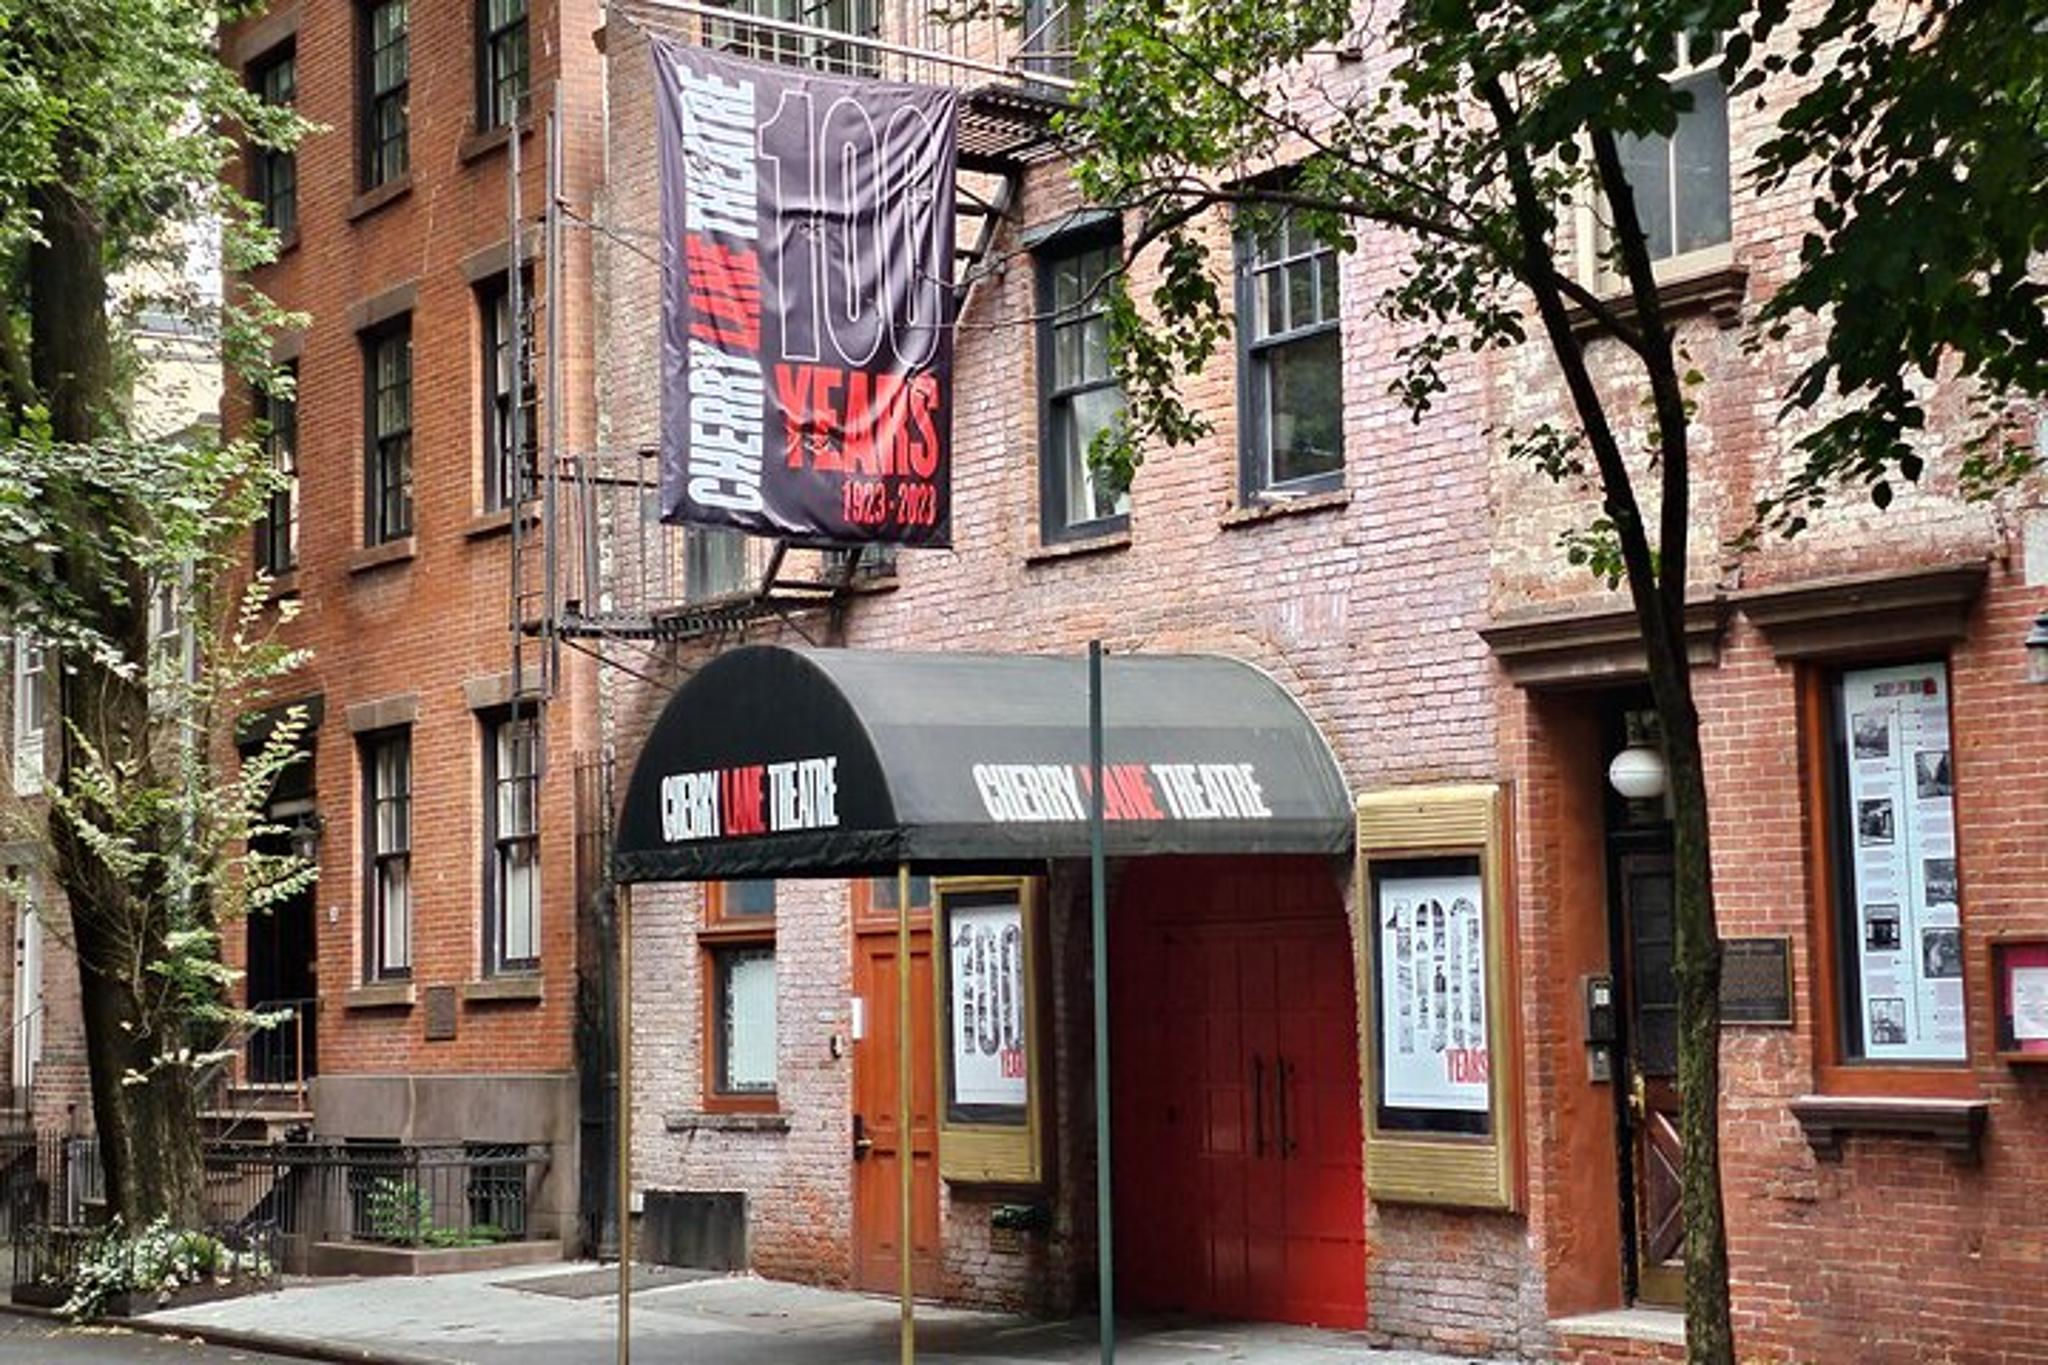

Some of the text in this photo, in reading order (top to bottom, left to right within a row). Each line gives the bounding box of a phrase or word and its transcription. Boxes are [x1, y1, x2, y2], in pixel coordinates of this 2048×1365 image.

[758, 89, 942, 367] 100
[677, 64, 764, 511] CHERRY LANE THEATRE
[774, 363, 940, 478] YEARS
[661, 756, 839, 842] CHERRY LANE THEATRE
[972, 764, 1086, 822] CHERRY
[1150, 763, 1273, 820] THEATRE
